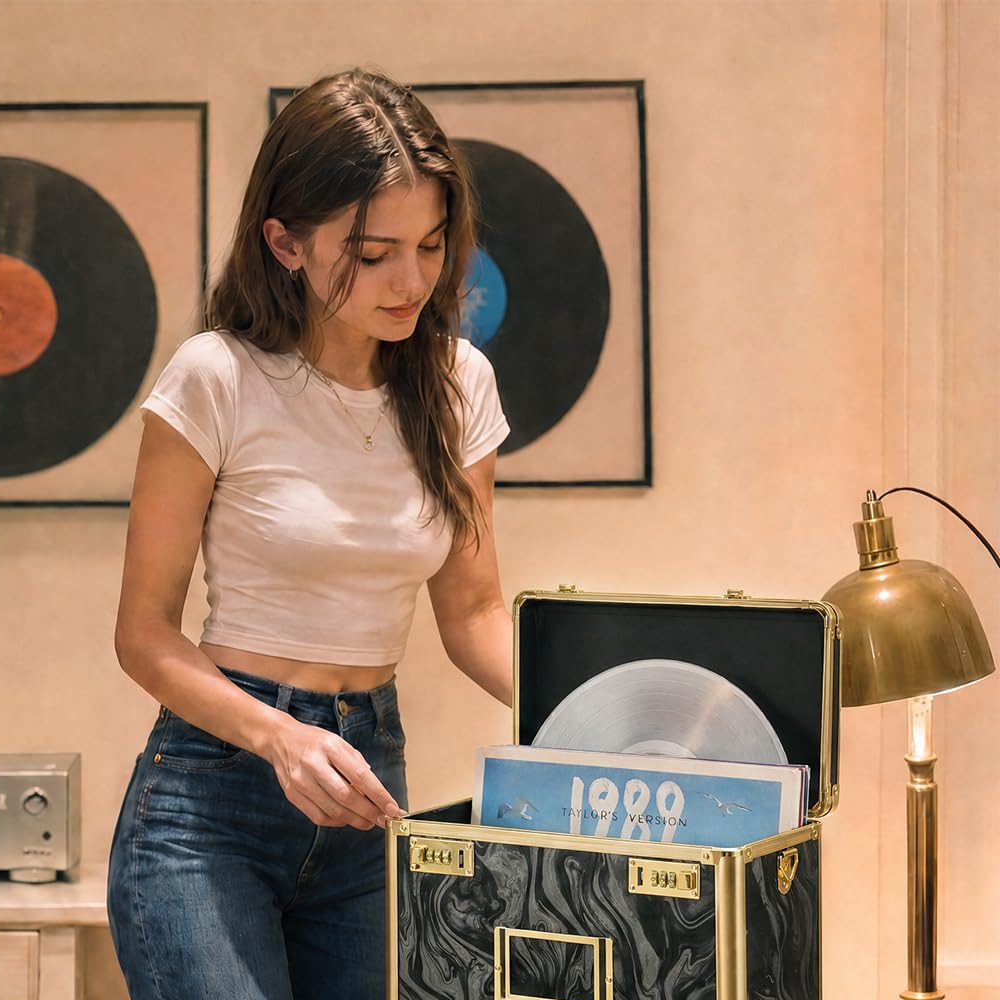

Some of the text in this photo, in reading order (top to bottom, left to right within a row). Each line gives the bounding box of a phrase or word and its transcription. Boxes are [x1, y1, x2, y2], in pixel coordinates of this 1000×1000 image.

[562, 808, 687, 827] TAYLOR'S VERSION
[570, 776, 685, 842] 1989
